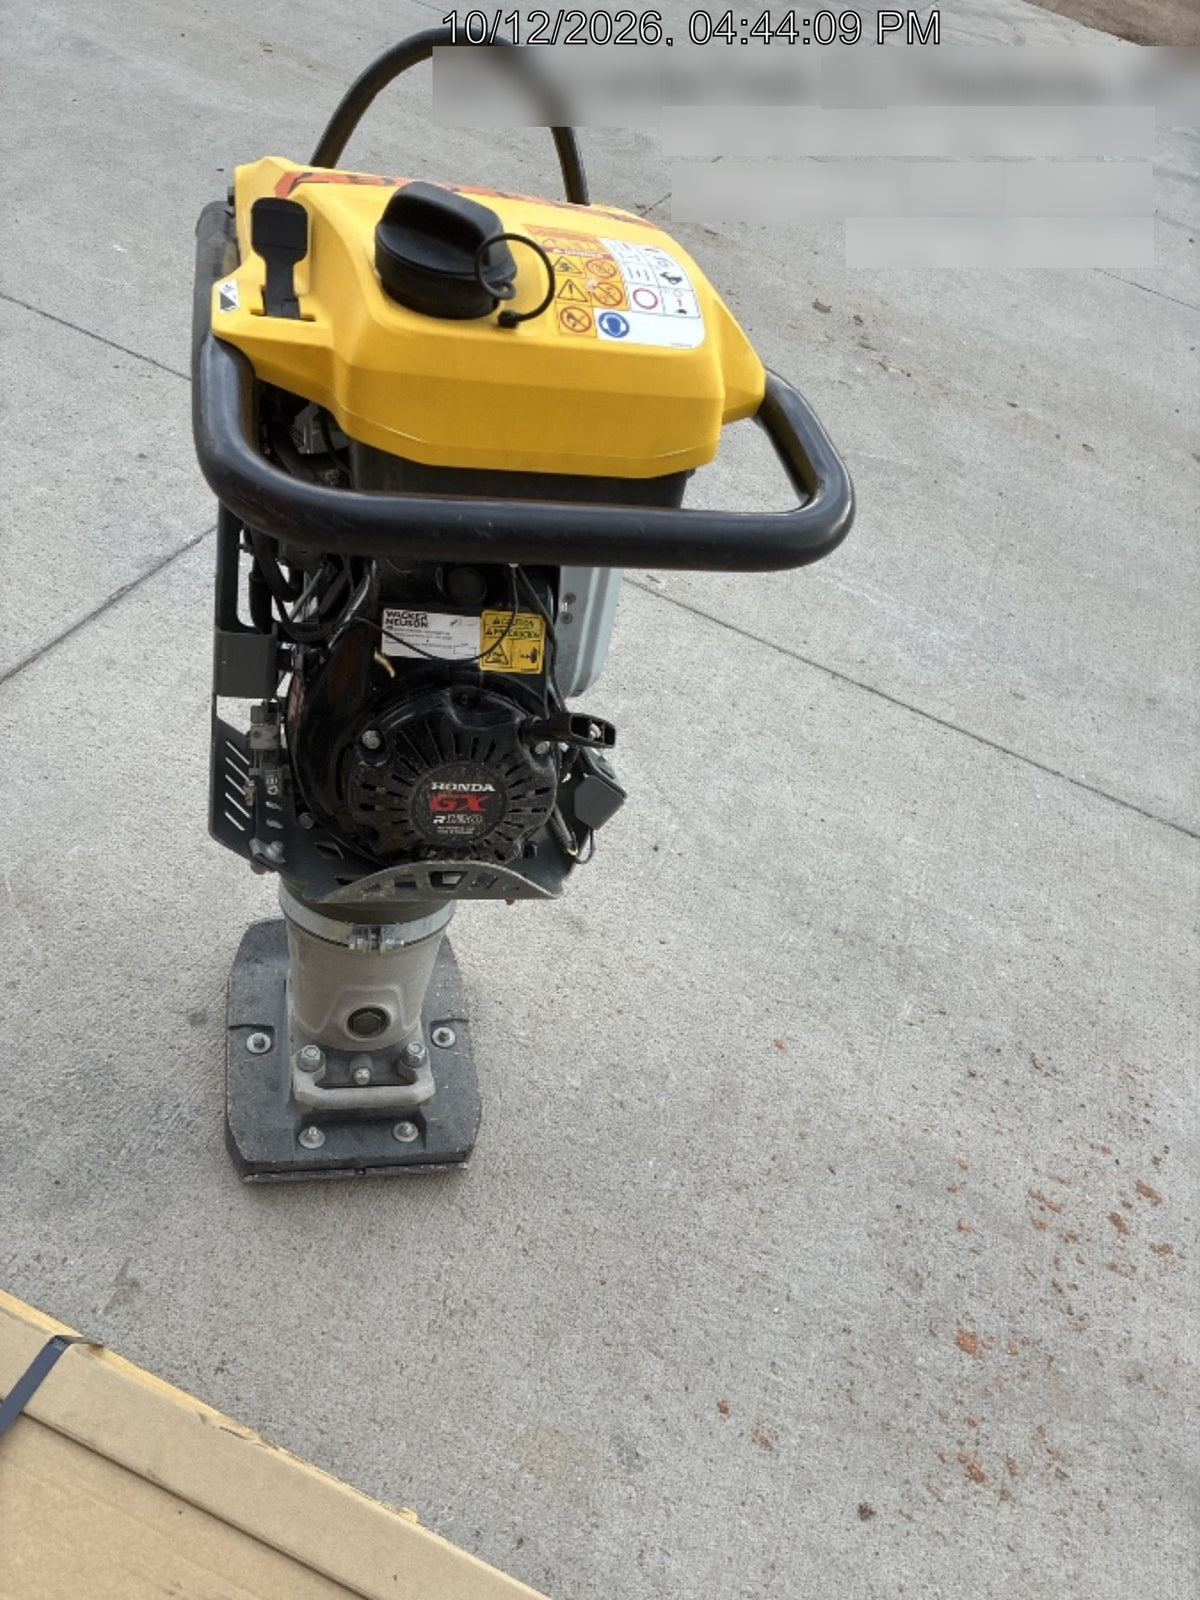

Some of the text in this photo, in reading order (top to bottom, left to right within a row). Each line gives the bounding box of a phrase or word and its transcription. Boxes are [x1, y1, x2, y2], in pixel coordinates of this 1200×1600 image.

[385, 611, 427, 621] WACKER
[385, 618, 429, 629] NEUSON
[430, 781, 496, 792] HONDA
[428, 793, 492, 812] GX
